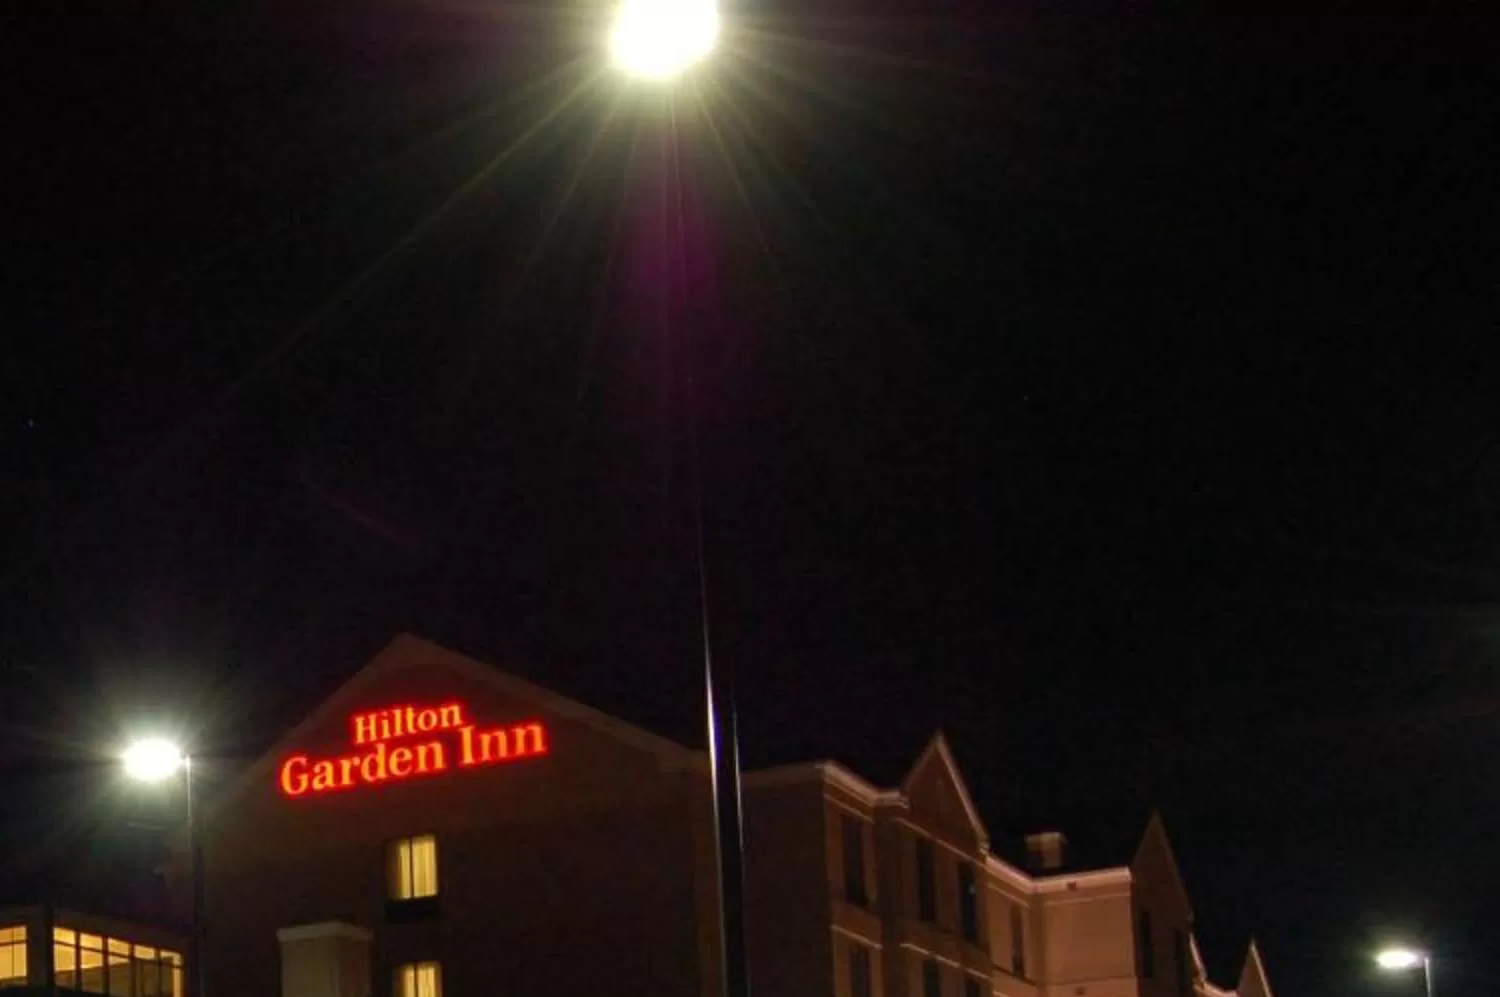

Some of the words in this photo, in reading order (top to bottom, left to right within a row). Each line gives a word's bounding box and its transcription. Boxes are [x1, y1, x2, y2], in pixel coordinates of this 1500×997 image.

[355, 704, 462, 744] Hilton
[280, 741, 445, 795] Garden
[459, 723, 546, 765] Inn
